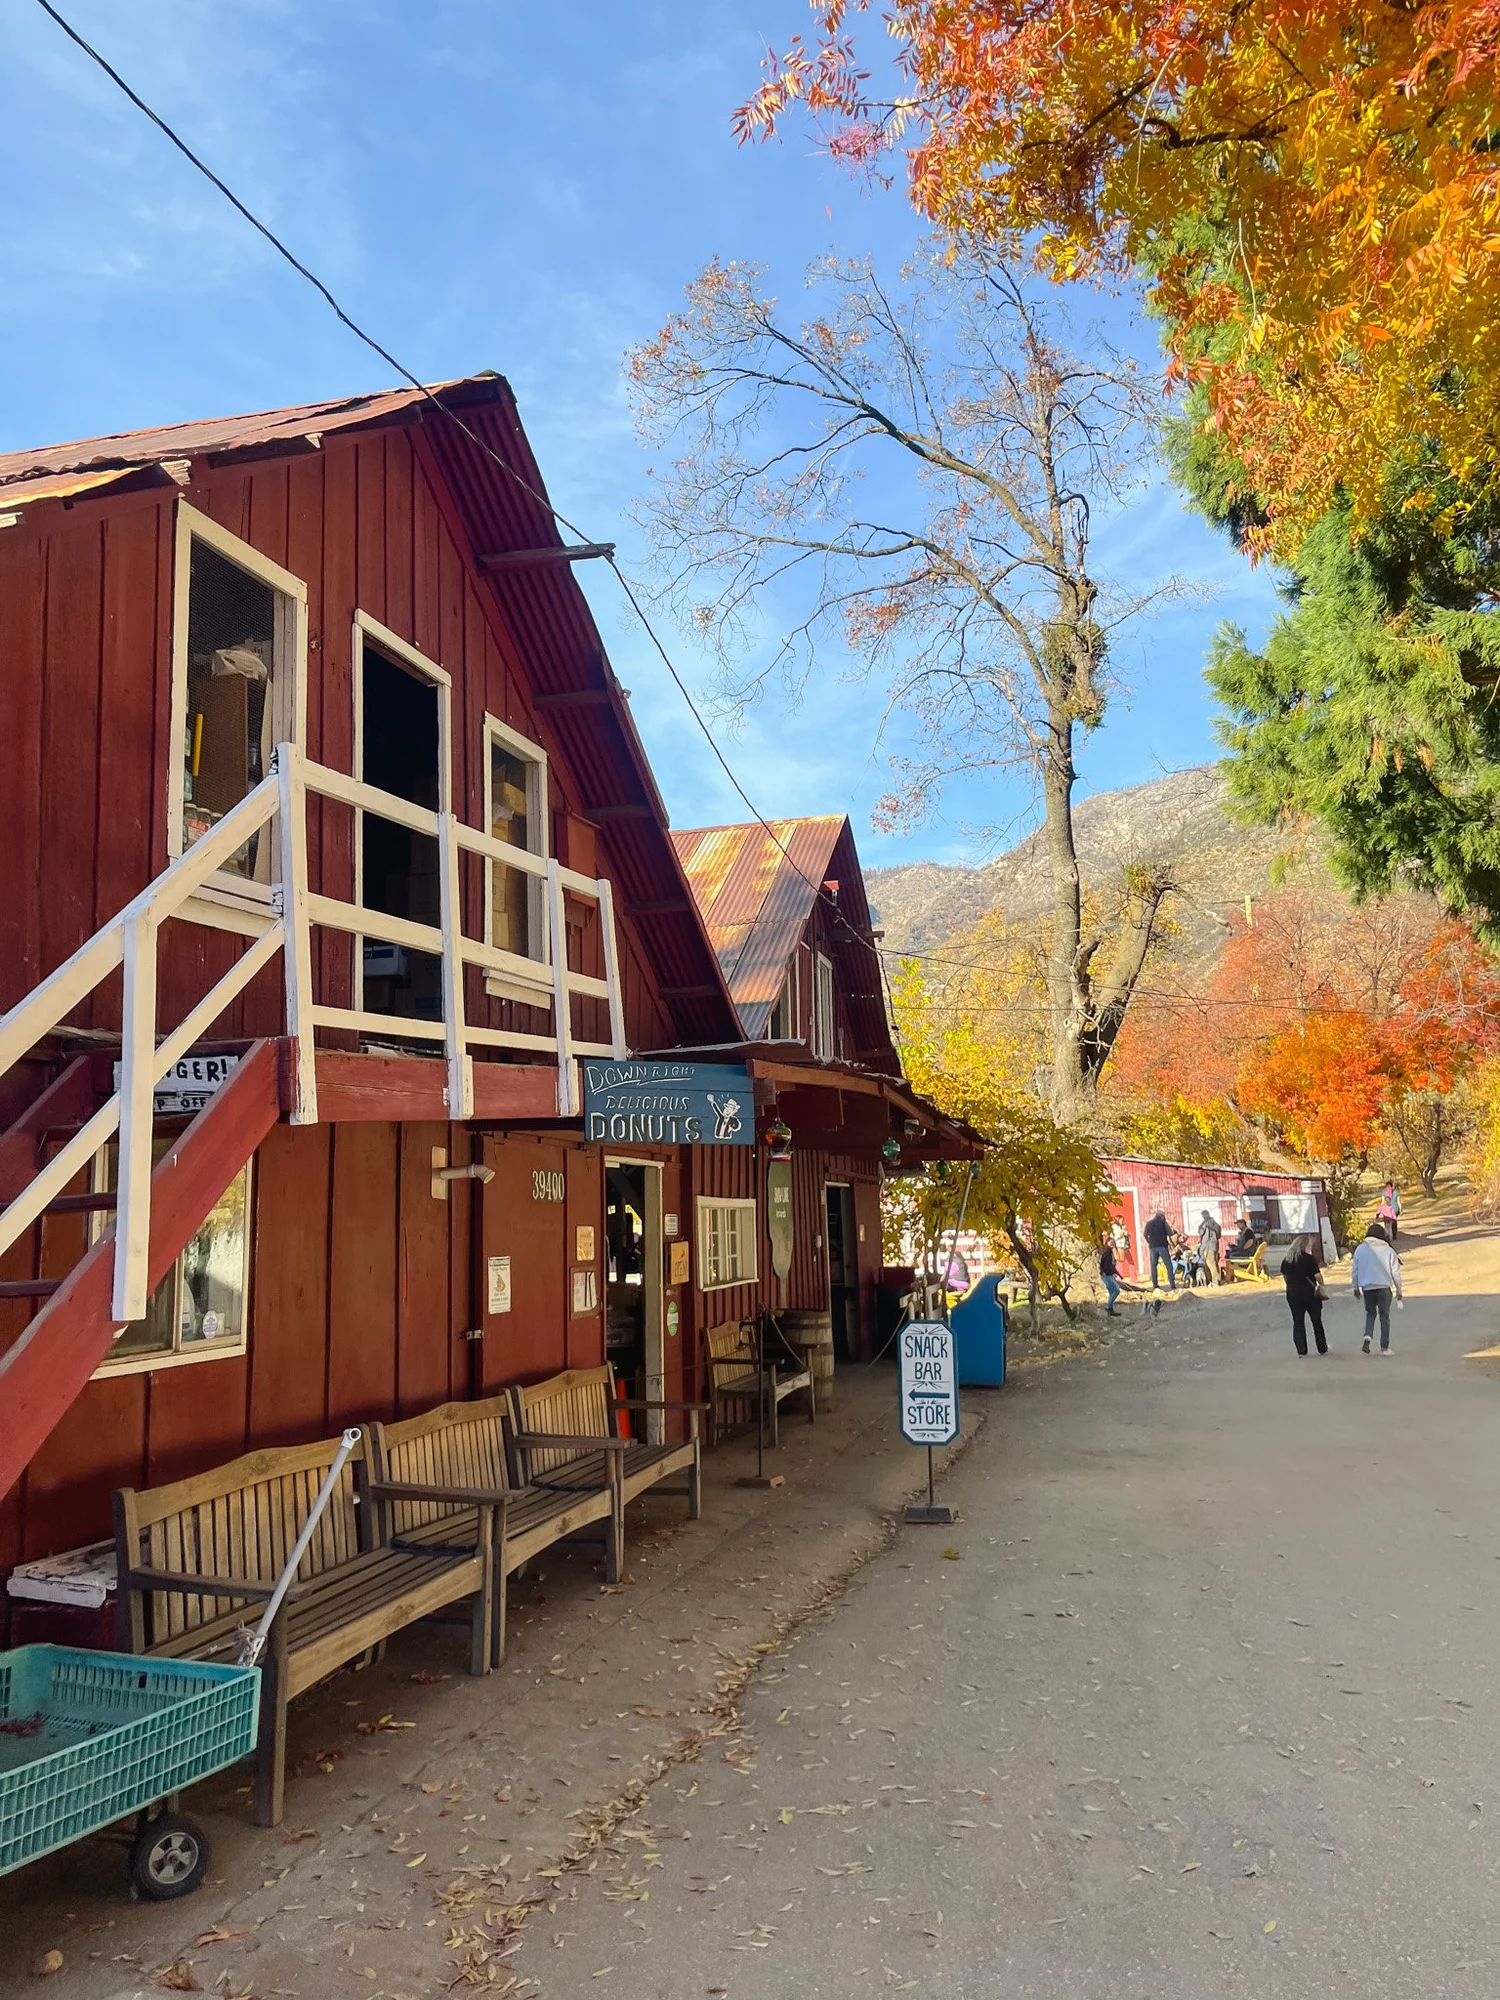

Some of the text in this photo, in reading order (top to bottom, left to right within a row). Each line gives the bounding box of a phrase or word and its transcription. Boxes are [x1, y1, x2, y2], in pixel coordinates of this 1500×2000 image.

[180, 1097, 206, 1108] OFF
[605, 1095, 690, 1110] DELICIOUS
[590, 1112, 702, 1143] DONUTS
[532, 1170, 565, 1200] 39400
[905, 1335, 948, 1358] SNACK
[914, 1361, 942, 1381] BAR
[908, 1405, 951, 1425] STORE
